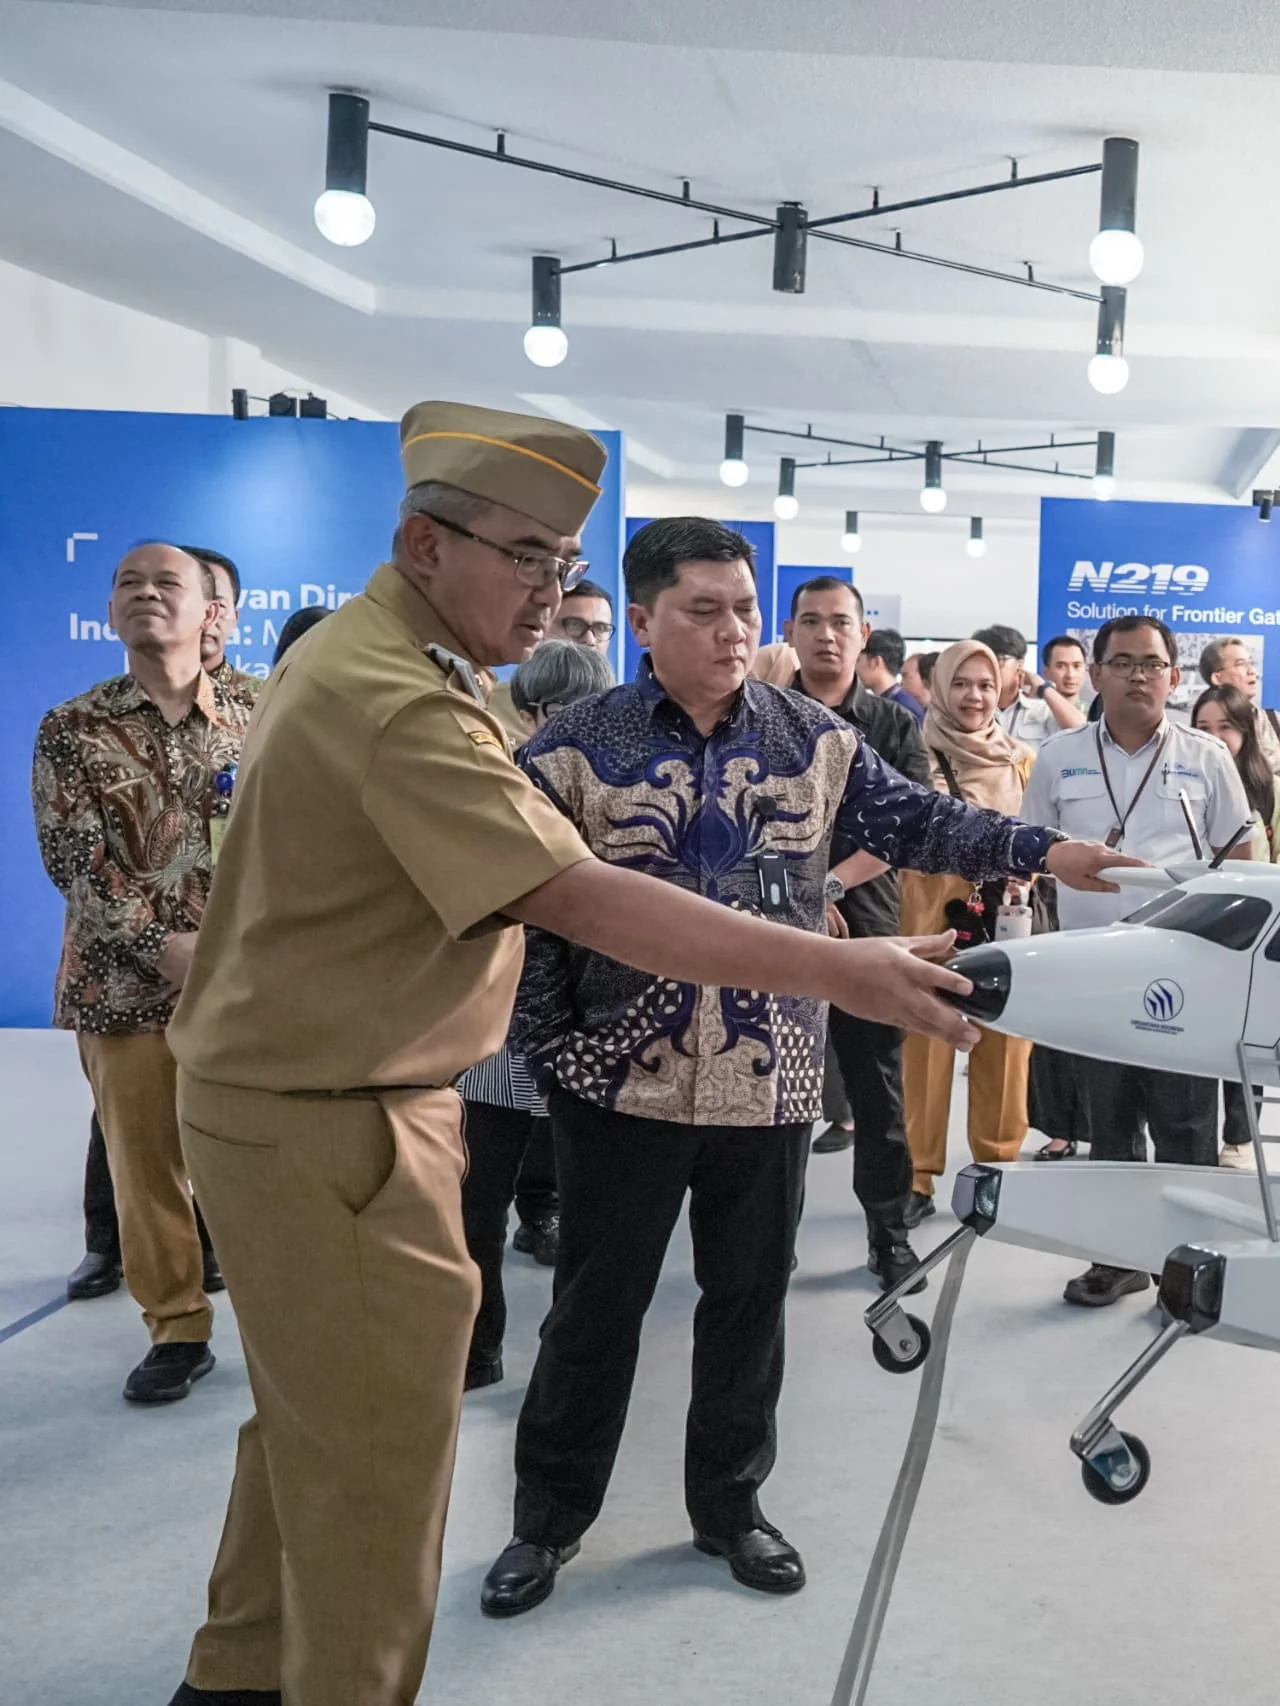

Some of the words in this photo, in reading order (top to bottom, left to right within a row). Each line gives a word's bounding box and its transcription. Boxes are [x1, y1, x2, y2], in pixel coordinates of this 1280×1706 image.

[1067, 560, 1210, 596] N219
[1067, 600, 1138, 620] Solution
[1143, 604, 1168, 621] for
[1172, 605, 1245, 625] Frontier
